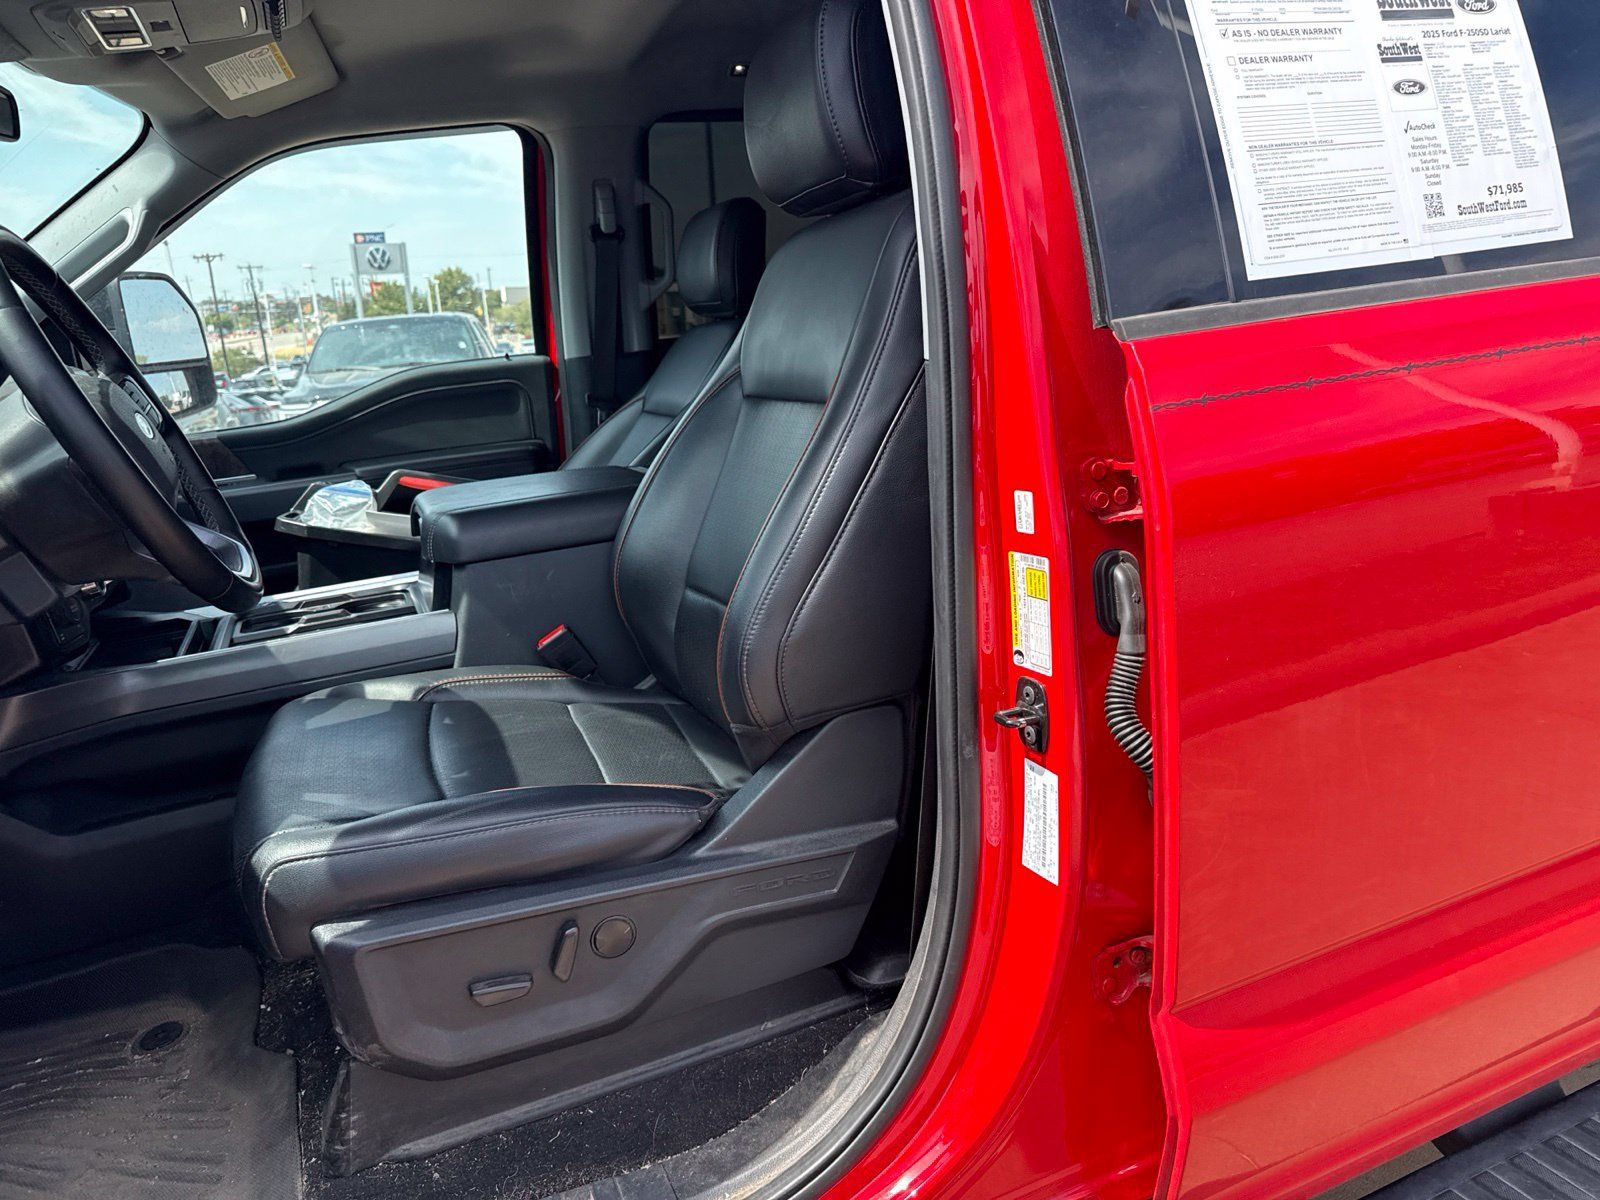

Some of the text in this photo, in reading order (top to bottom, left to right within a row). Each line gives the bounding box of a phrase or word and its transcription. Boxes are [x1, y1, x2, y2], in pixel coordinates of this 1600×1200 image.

[1270, 28, 1300, 36] DEALER
[1421, 27, 1512, 38] 2025 Ford F-250SD Lariat
[1377, 42, 1421, 56] SouthWest
[1238, 55, 1313, 64] DEALER WARRANTY
[1409, 122, 1435, 130] AutoCheck
[1487, 182, 1523, 197] $71,985
[1458, 199, 1527, 216] SouthWestFord.com
